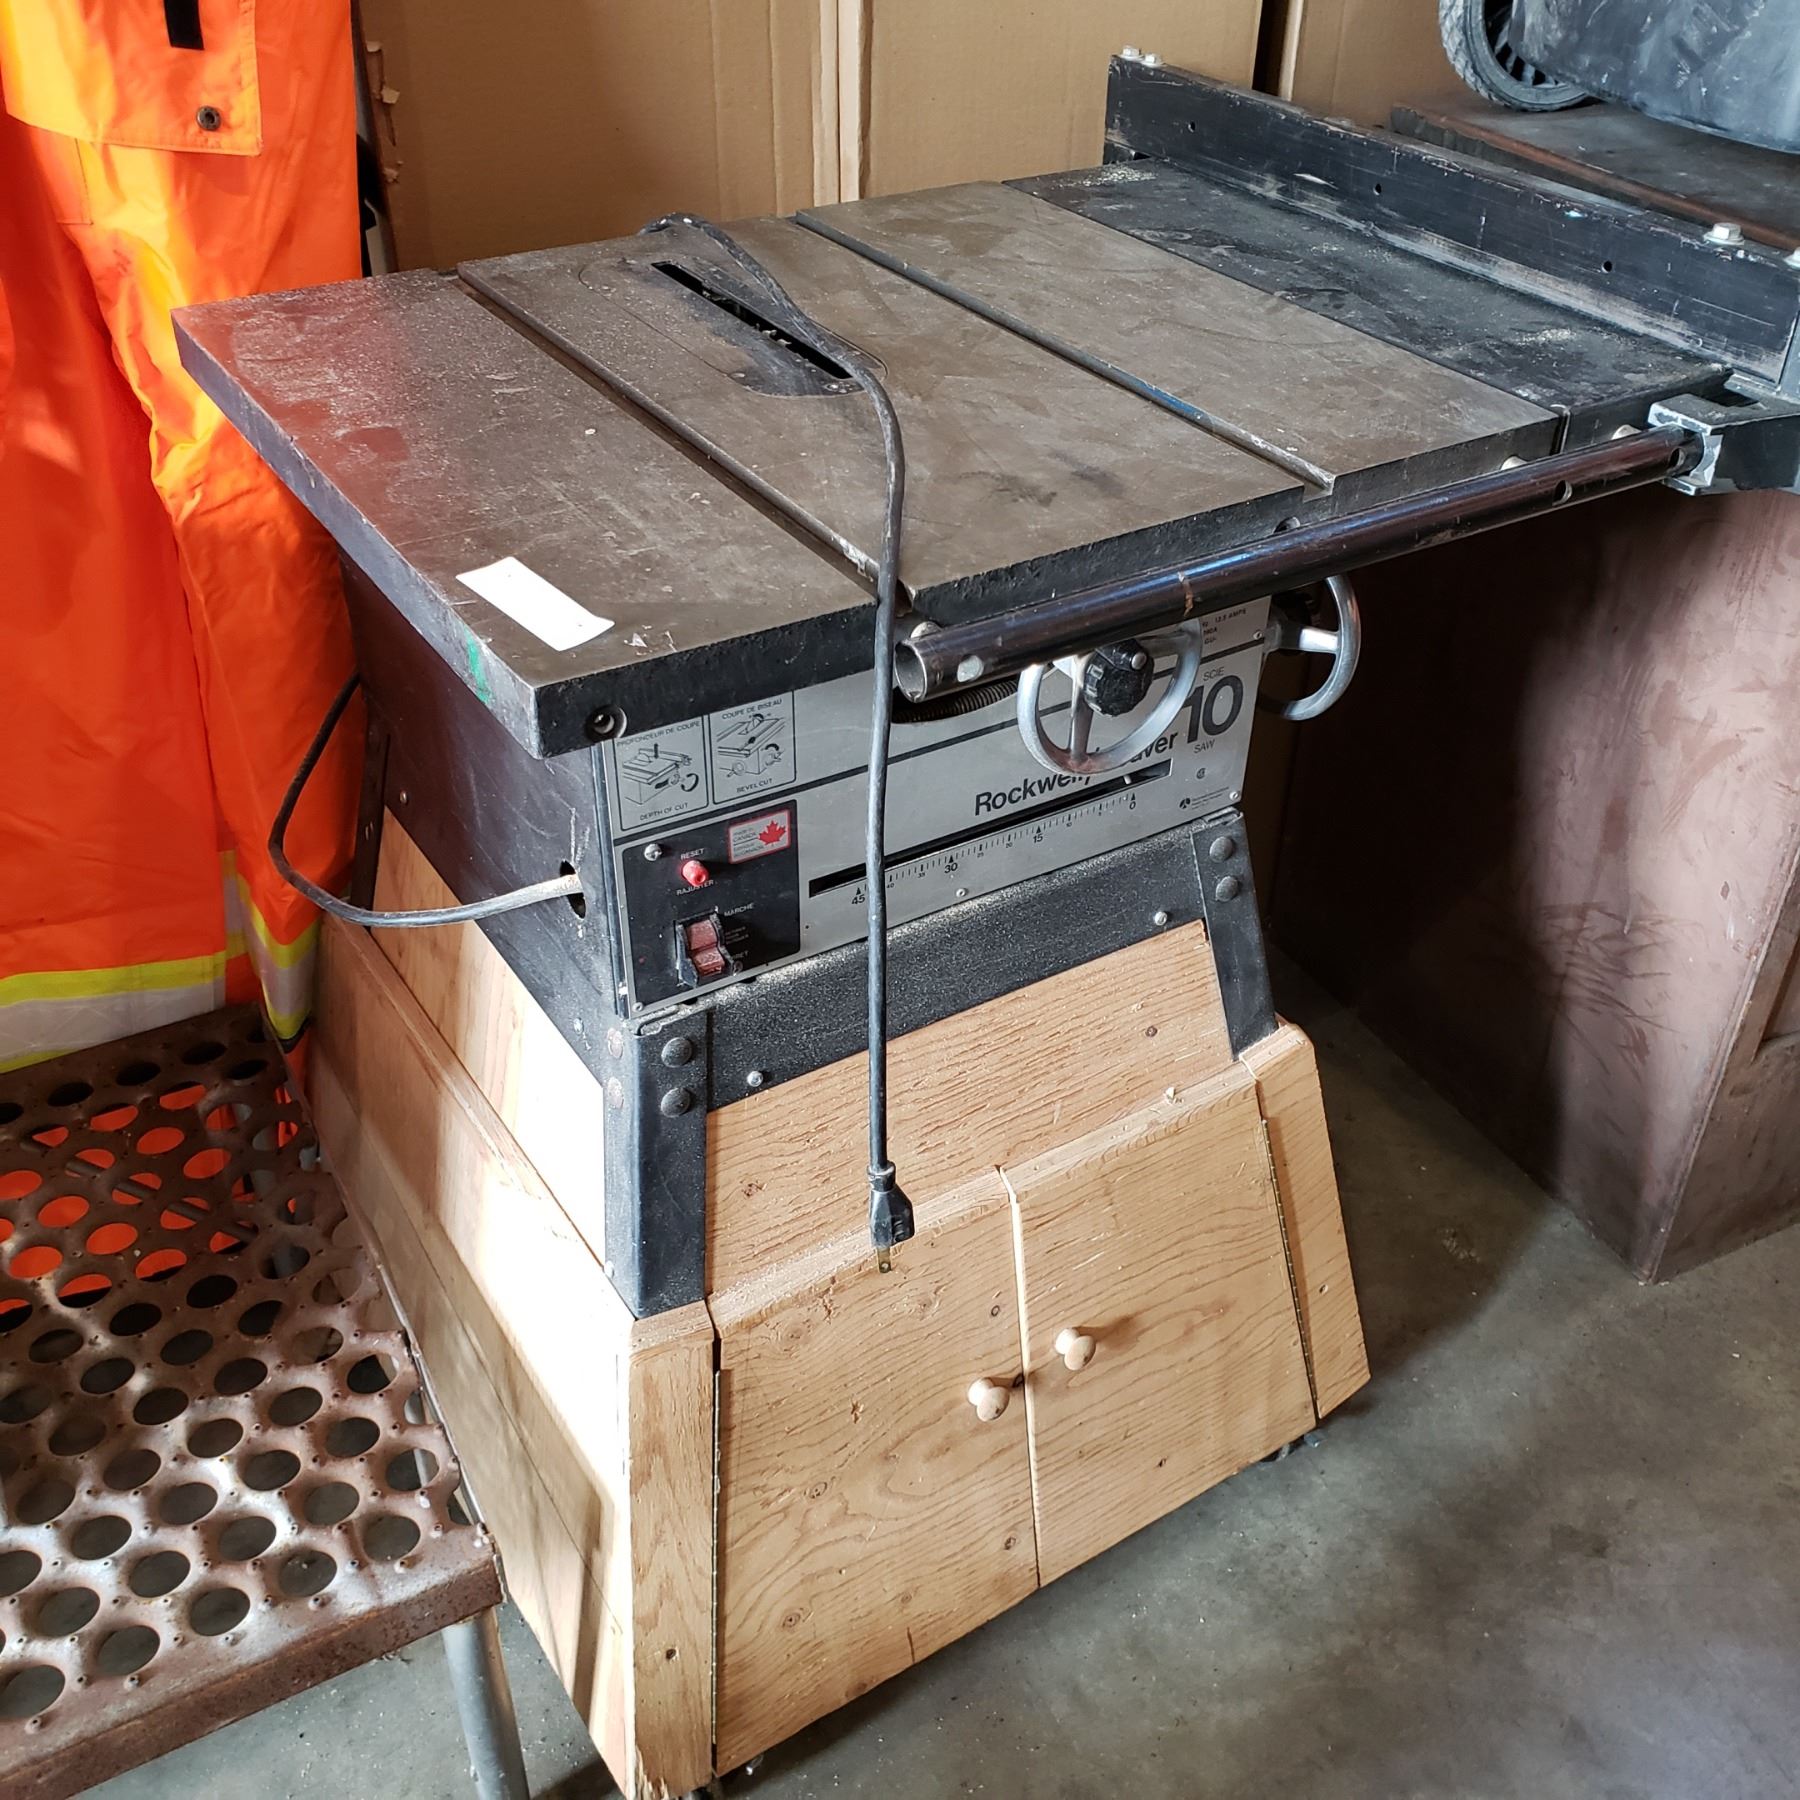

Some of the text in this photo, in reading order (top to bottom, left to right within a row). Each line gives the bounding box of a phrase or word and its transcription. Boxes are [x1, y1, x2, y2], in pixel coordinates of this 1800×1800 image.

[1203, 667, 1225, 681] SCIE
[722, 699, 782, 720] COUPE DE BISEAU
[1182, 675, 1244, 744] 10
[665, 727, 674, 735] DE
[676, 720, 701, 732] COUPE
[1194, 739, 1216, 754] SAW
[736, 778, 773, 793] BEVEL CUT
[640, 802, 688, 821] DEPTH OF CUT
[680, 848, 704, 860] RESET
[851, 893, 866, 905] 45
[944, 862, 958, 874] 30
[976, 851, 985, 859] 25
[1033, 833, 1044, 843] 15
[1129, 801, 1137, 810] 0
[676, 879, 714, 896] RAJUSTER
[724, 902, 755, 917] MARCHE
